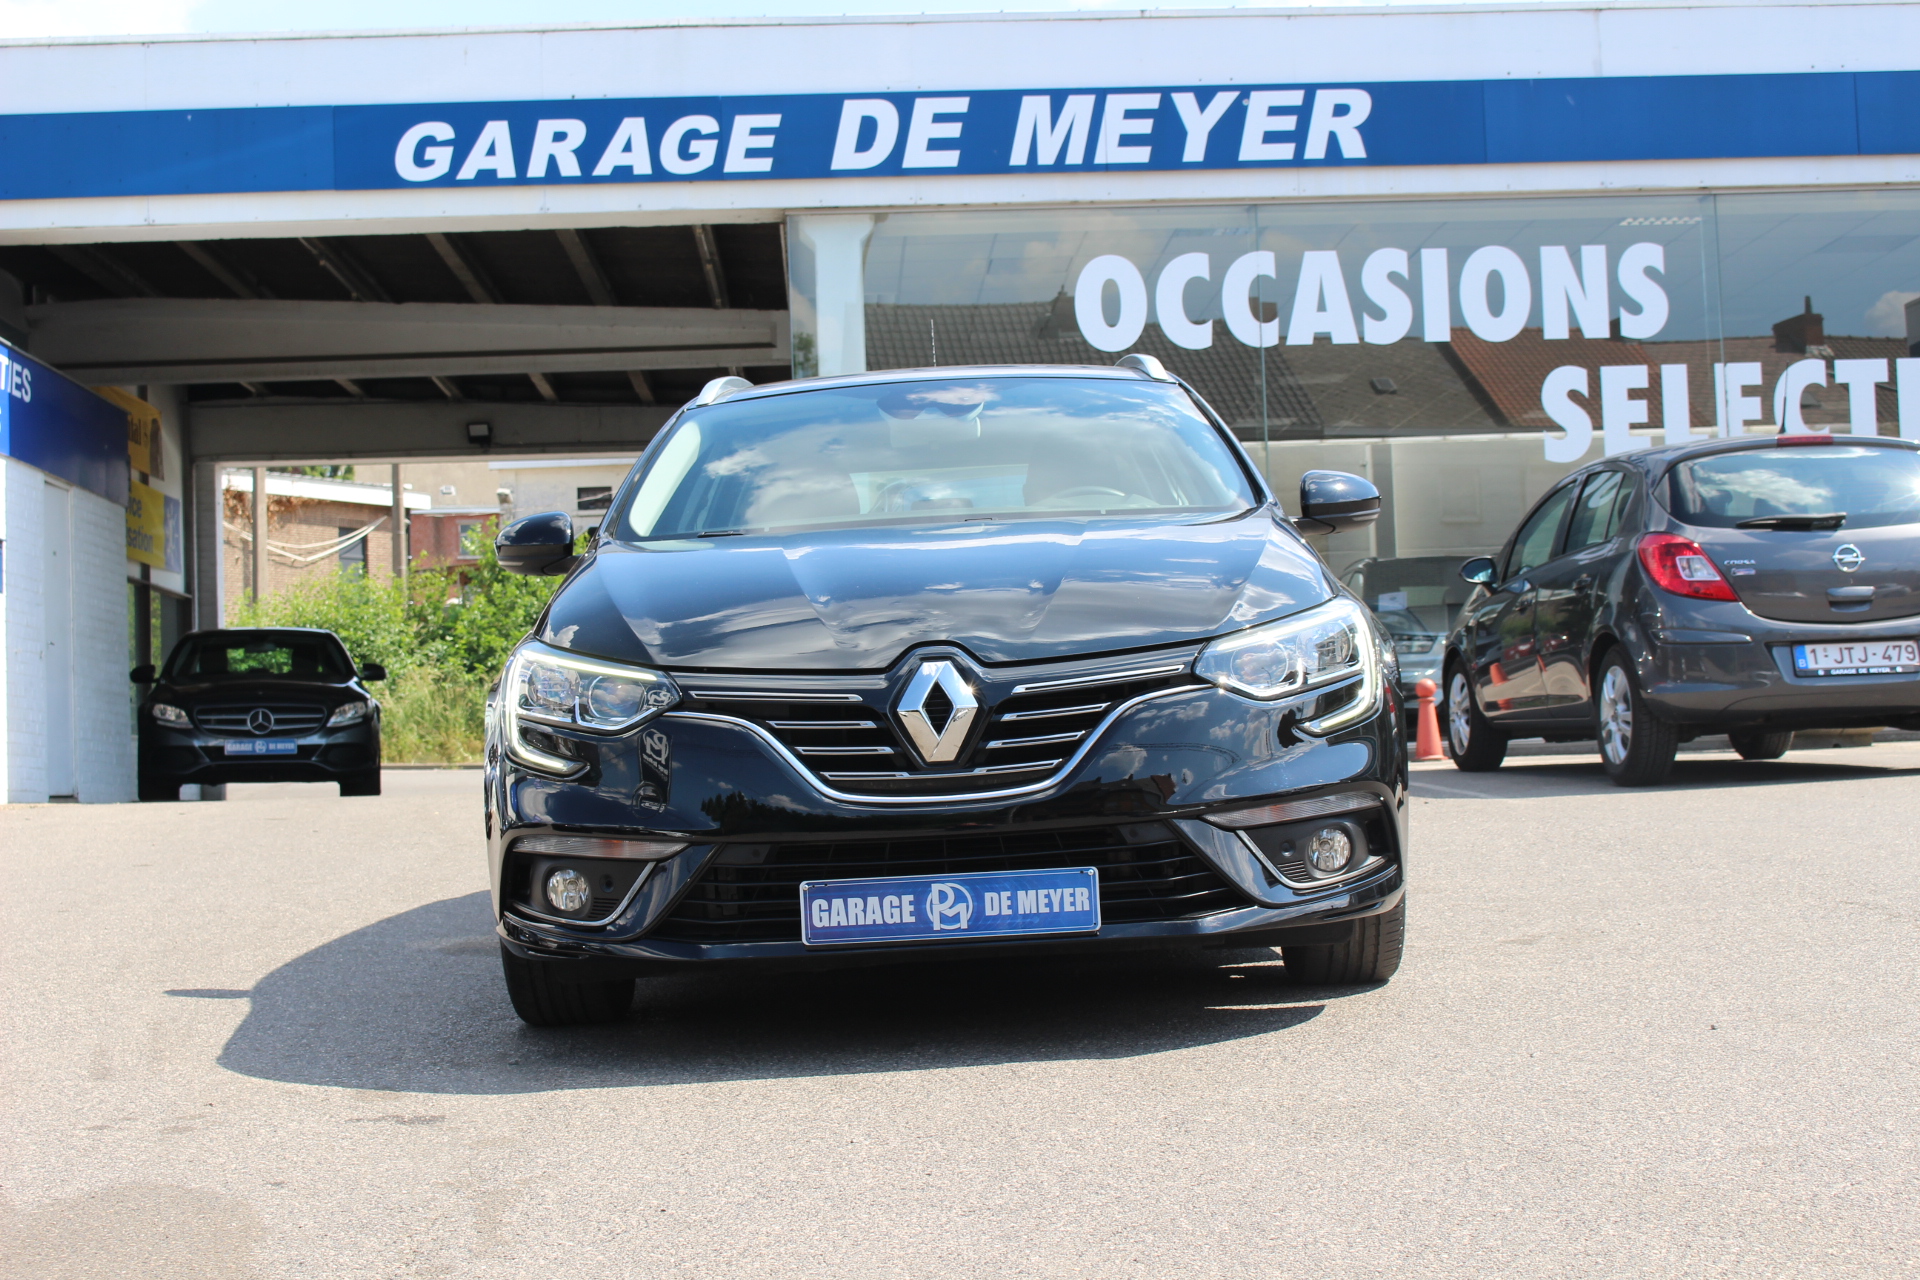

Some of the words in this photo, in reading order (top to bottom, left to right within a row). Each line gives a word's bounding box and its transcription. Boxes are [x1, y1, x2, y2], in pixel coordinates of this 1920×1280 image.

[394, 113, 782, 183] GARAGE
[830, 96, 971, 171] DE
[1008, 88, 1373, 166] MEYER
[1074, 241, 1670, 353] OCCASIONS
[1798, 658, 1807, 667] B
[227, 743, 253, 751] GARAGE
[811, 895, 916, 928] GARAGE
[984, 891, 1013, 916] DE
[1017, 887, 1090, 915] MEYER
